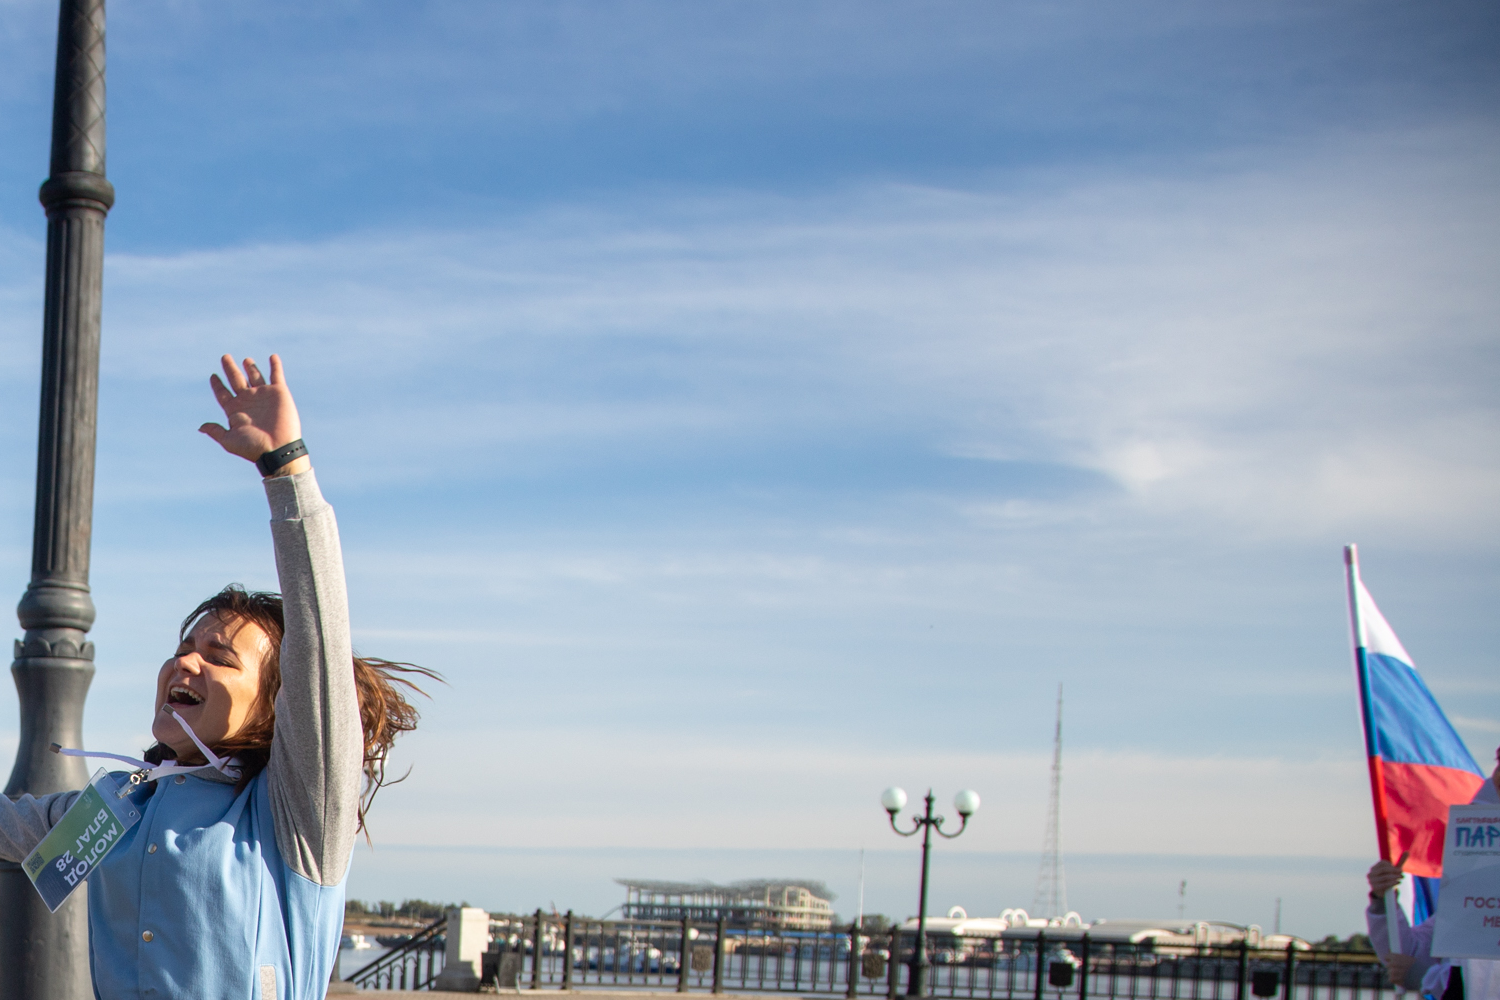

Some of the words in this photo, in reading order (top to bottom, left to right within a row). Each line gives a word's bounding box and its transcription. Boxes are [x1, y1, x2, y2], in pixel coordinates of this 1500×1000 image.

[75, 808, 109, 854] БЛАГ
[55, 849, 74, 872] 28
[63, 822, 118, 887] МОЛОД
